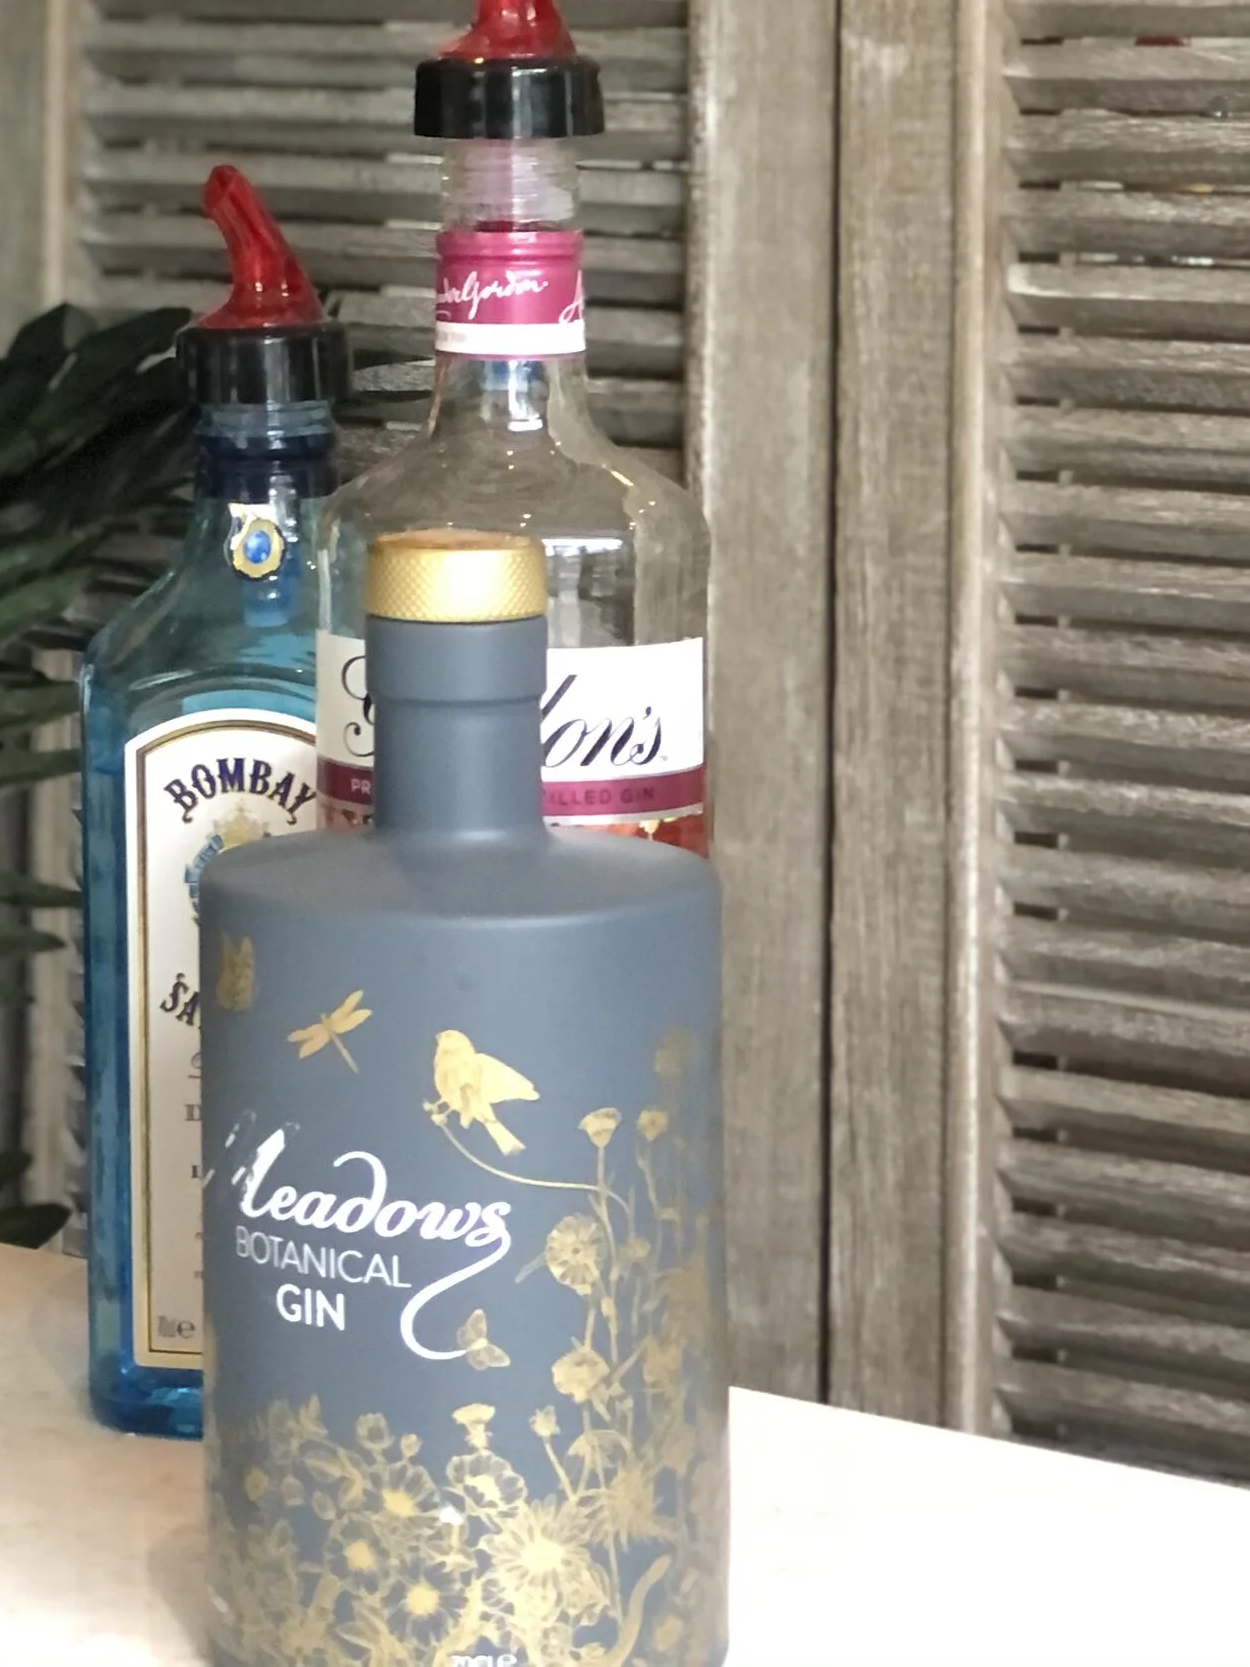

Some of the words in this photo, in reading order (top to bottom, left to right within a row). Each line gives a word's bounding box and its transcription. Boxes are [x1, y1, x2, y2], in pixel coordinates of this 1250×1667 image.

[163, 757, 318, 825] BOMBAY
[545, 788, 612, 806] ILLED
[235, 1225, 412, 1288] BOTANICAL
[275, 1283, 346, 1331] GIN
